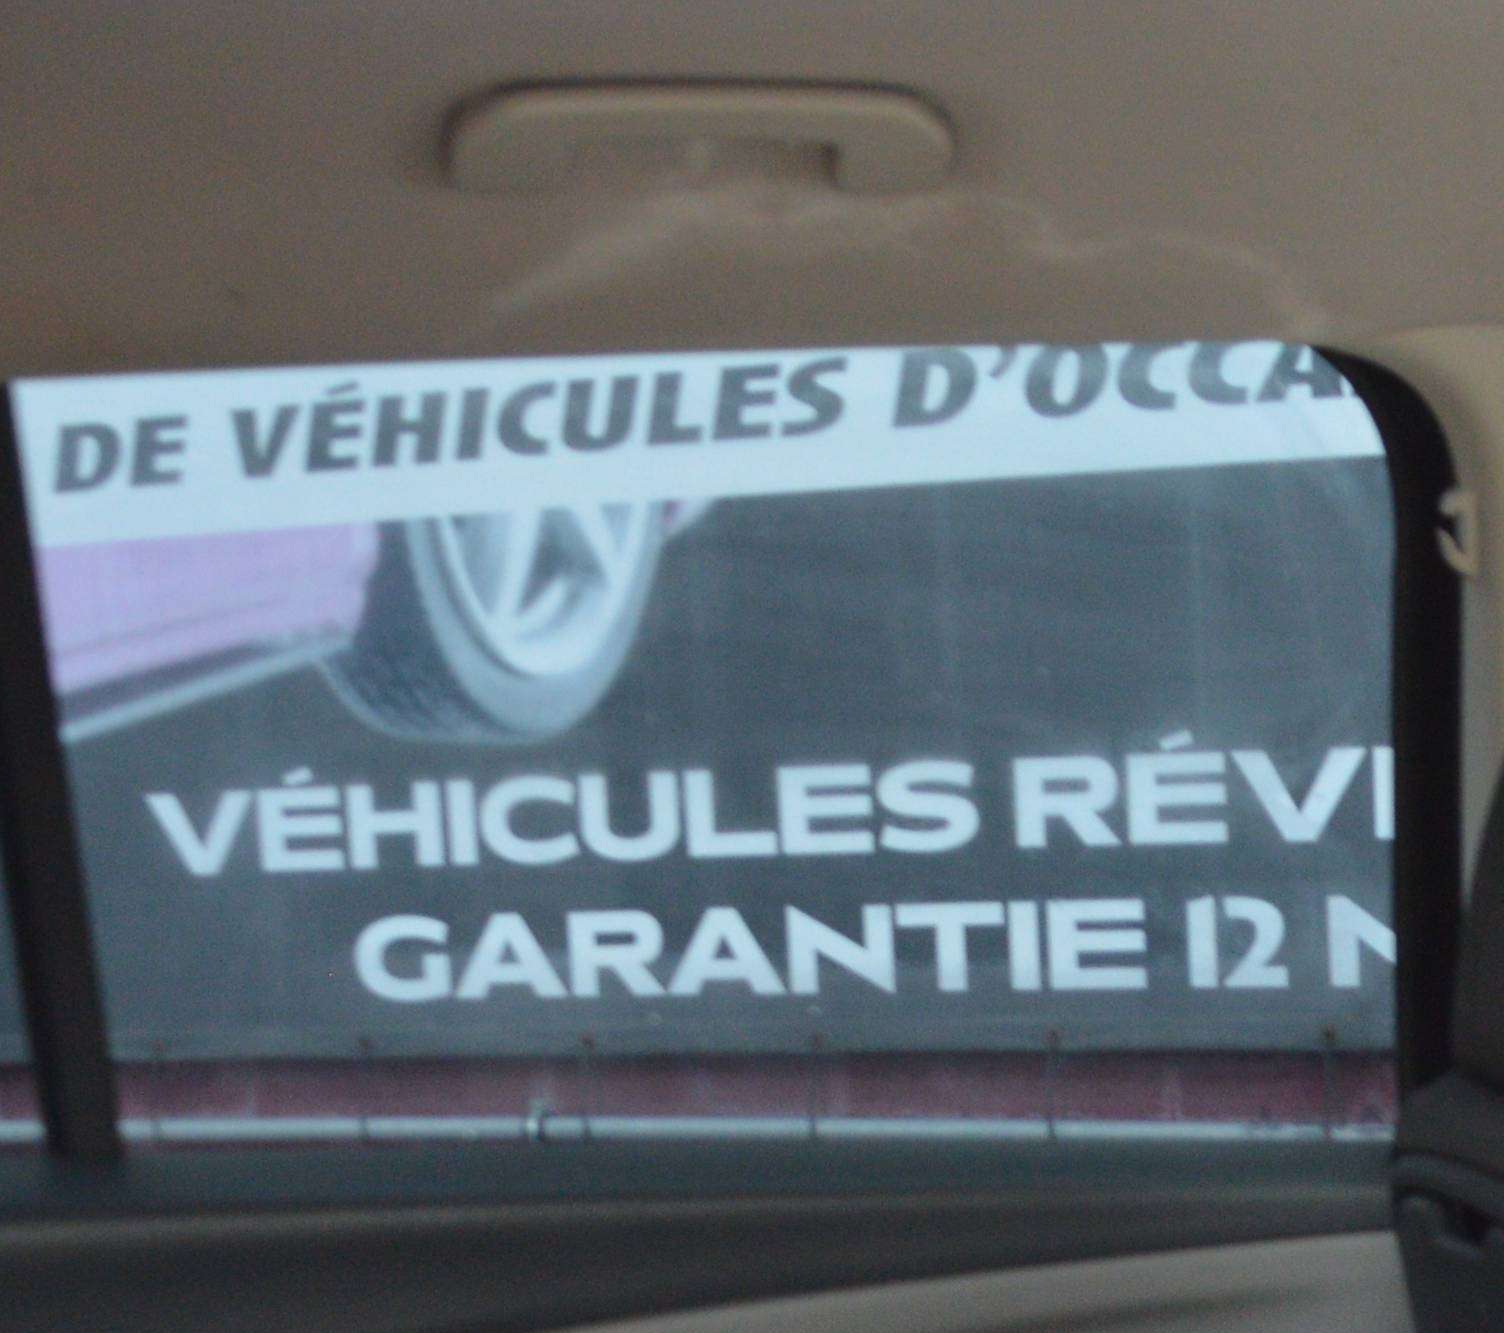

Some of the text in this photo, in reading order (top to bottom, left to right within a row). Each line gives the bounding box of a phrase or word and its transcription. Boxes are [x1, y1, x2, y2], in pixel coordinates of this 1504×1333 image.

[53, 416, 190, 495] DE
[228, 356, 848, 481] VÉHICULES
[145, 728, 1394, 877] VÉHICULES RÉVI
[353, 895, 1149, 1000] GARANTIE
[1185, 894, 1290, 990] 12
